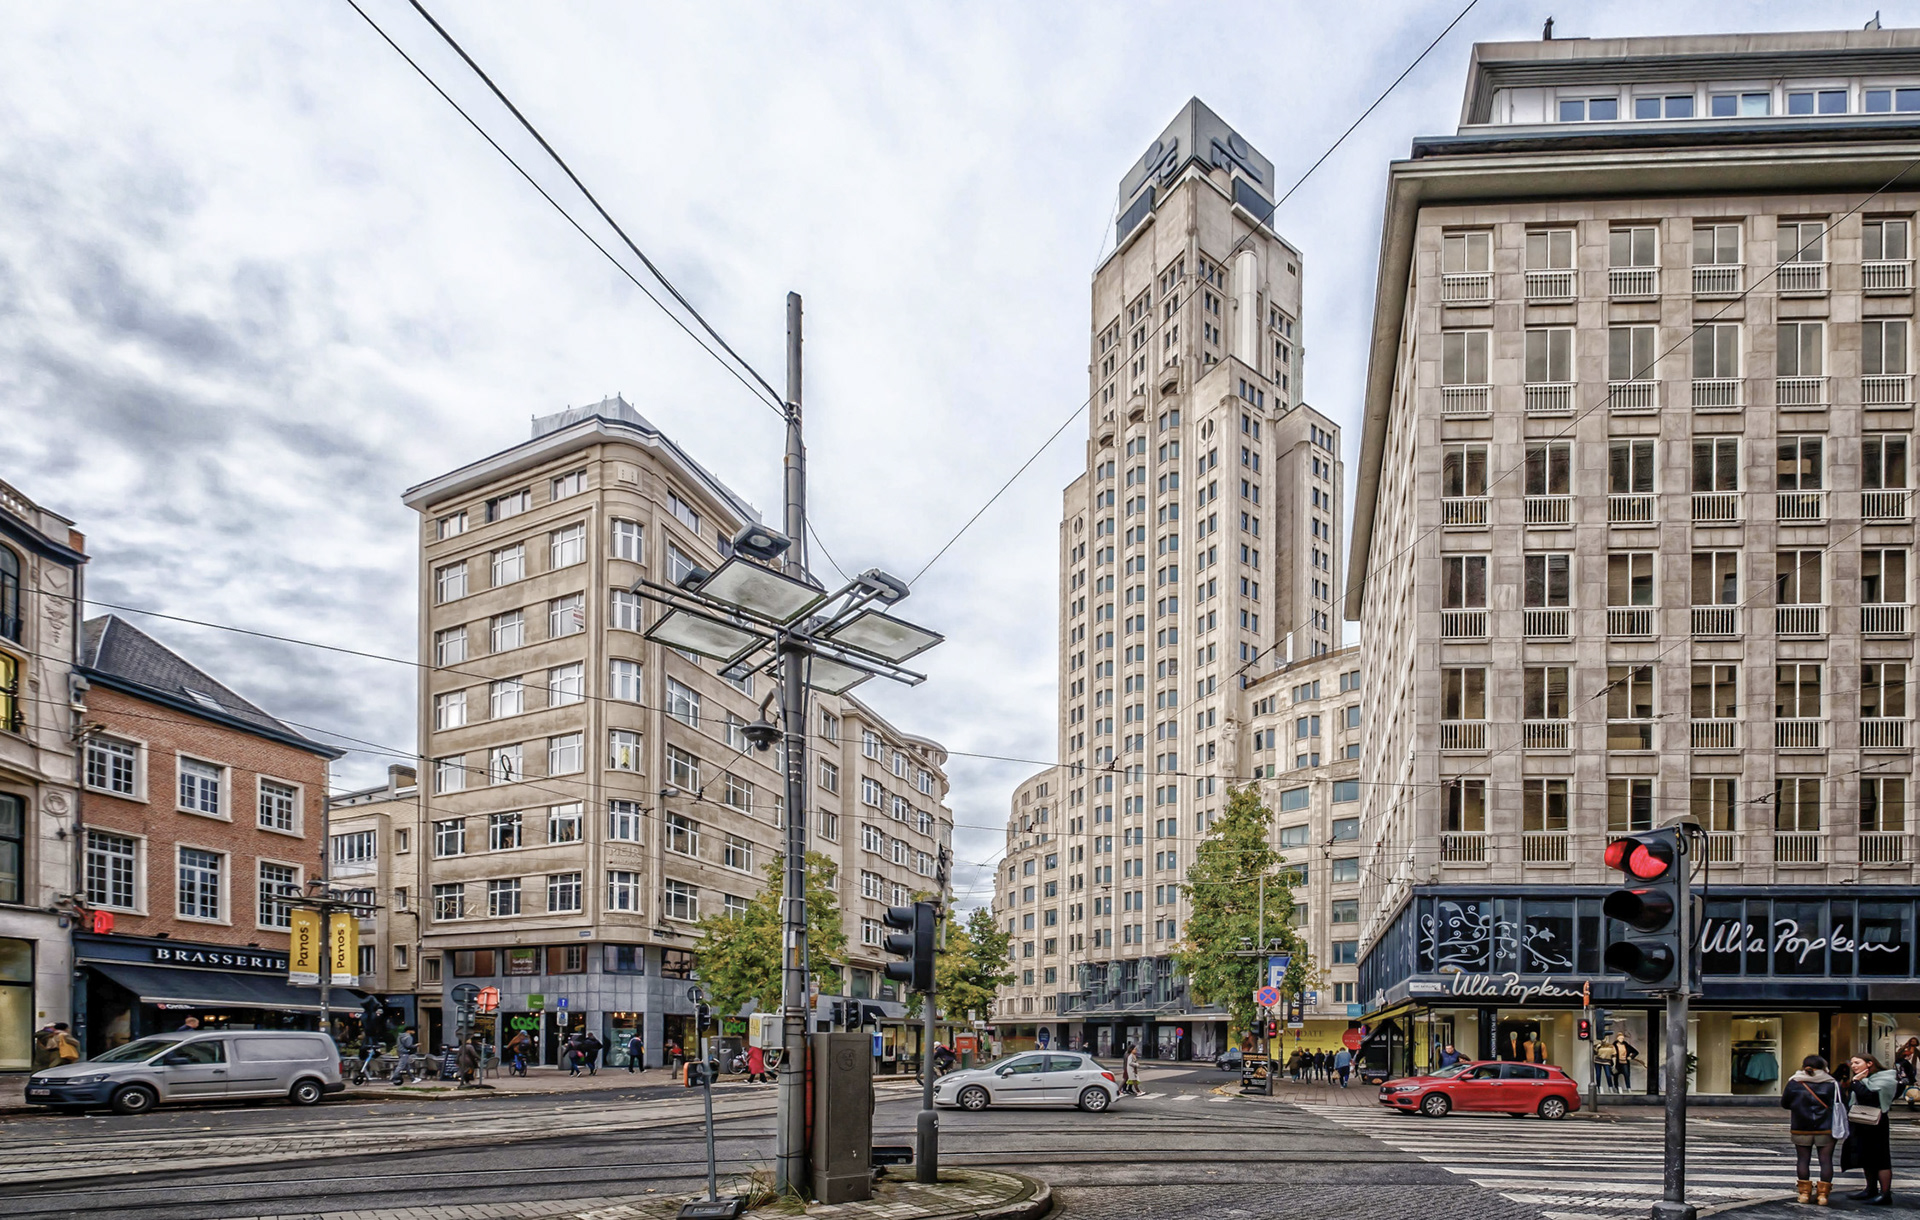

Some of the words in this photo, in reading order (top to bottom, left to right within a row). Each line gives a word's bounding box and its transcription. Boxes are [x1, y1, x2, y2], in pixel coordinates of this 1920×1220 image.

[608, 847, 642, 859] MEIR
[297, 926, 309, 967] Panos
[336, 929, 345, 968] Panos
[1701, 918, 1766, 953] Ulla
[1773, 918, 1900, 964] Popken
[156, 948, 287, 970] BRASSERIE
[1452, 971, 1498, 997] Ulla
[1502, 971, 1584, 1004] Popken
[723, 1021, 746, 1033] asa
[1878, 1025, 1894, 1040] JP
